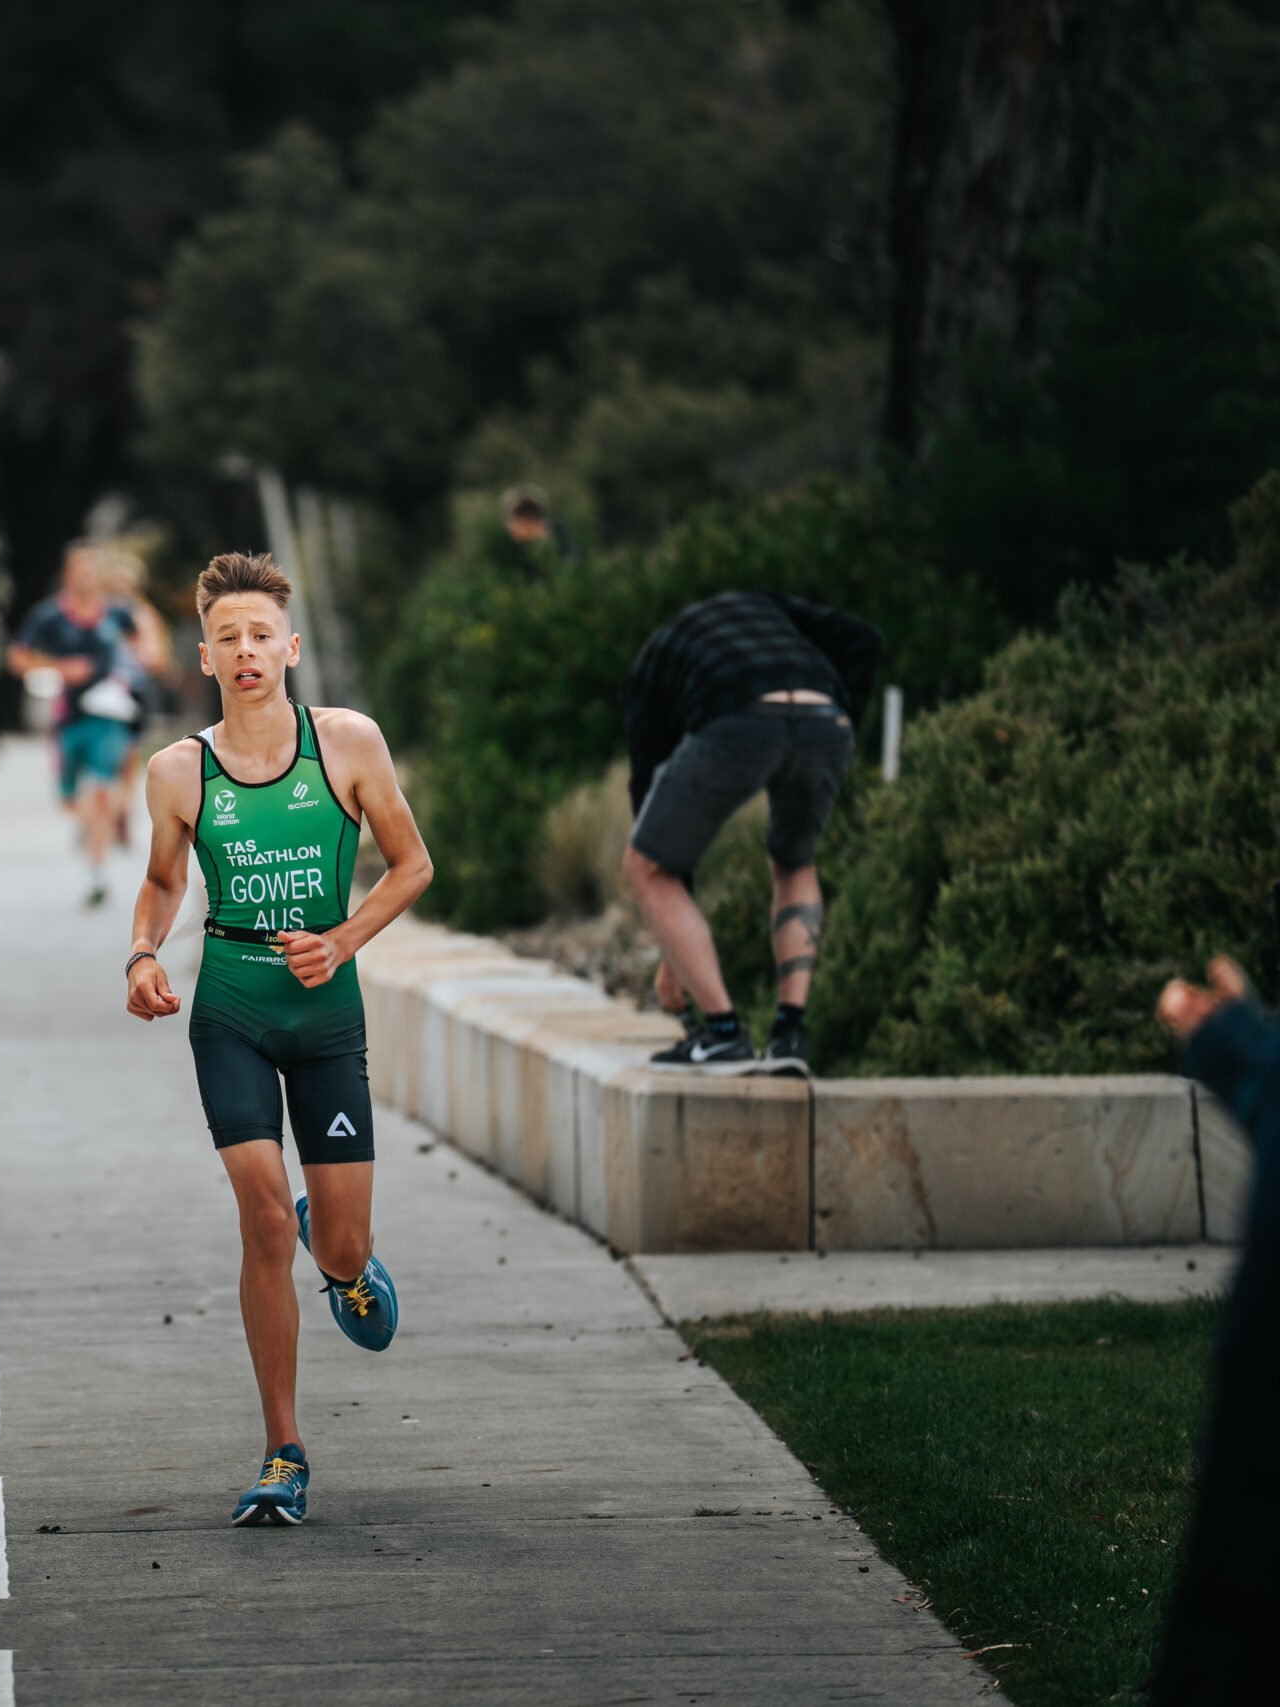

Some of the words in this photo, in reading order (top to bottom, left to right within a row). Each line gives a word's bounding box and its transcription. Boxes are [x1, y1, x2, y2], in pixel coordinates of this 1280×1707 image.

[287, 799, 319, 810] SCODY
[213, 818, 240, 826] Triathlon
[222, 839, 257, 855] TAS
[226, 844, 322, 867] TRIATHLON
[230, 867, 325, 904] GOWER
[253, 906, 305, 931] AUS
[241, 954, 287, 963] FAIRBRO
